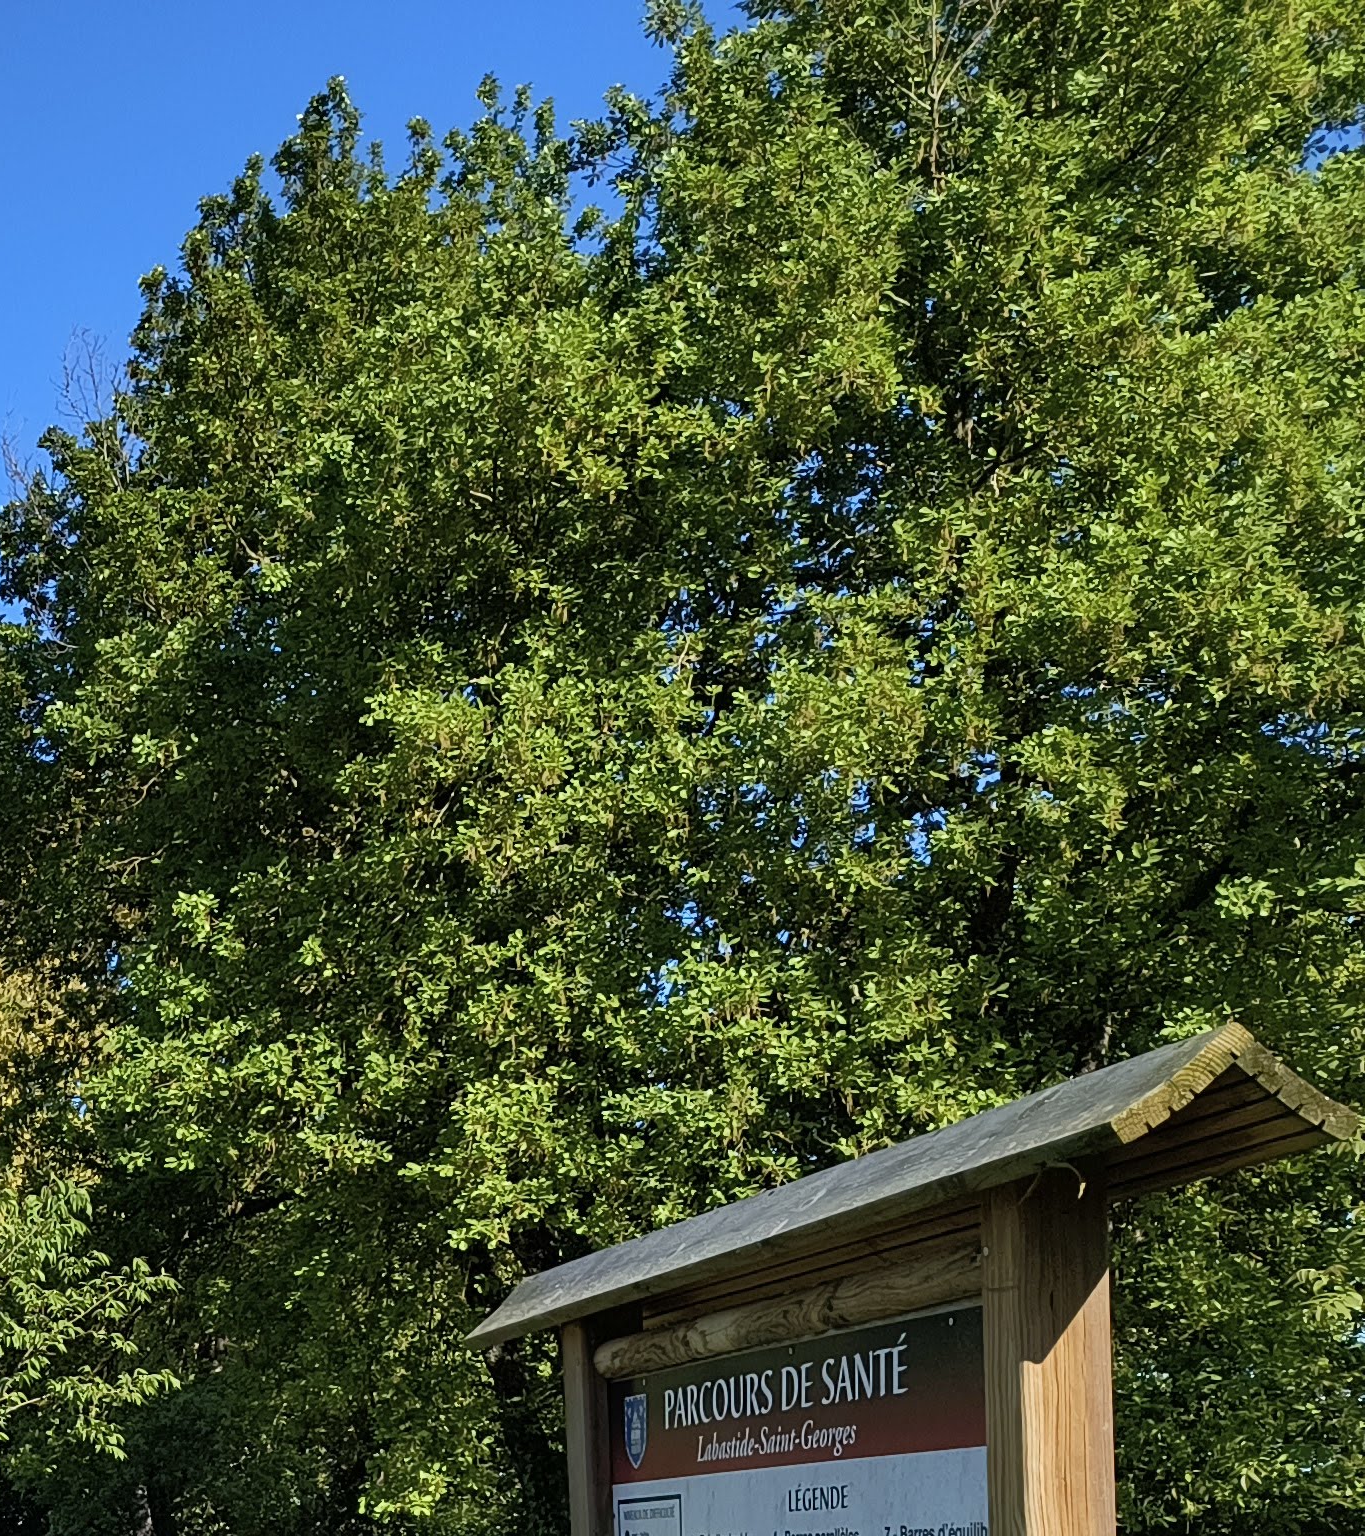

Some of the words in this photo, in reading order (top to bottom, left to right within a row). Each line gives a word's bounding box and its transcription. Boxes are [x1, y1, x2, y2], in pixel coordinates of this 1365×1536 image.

[663, 1369, 773, 1430] PARCOURS
[780, 1361, 814, 1412] DE
[821, 1332, 909, 1405] SANTÉ
[696, 1419, 857, 1462] Labastide-Saint-Georges
[788, 1483, 849, 1512] LÉGENDE
